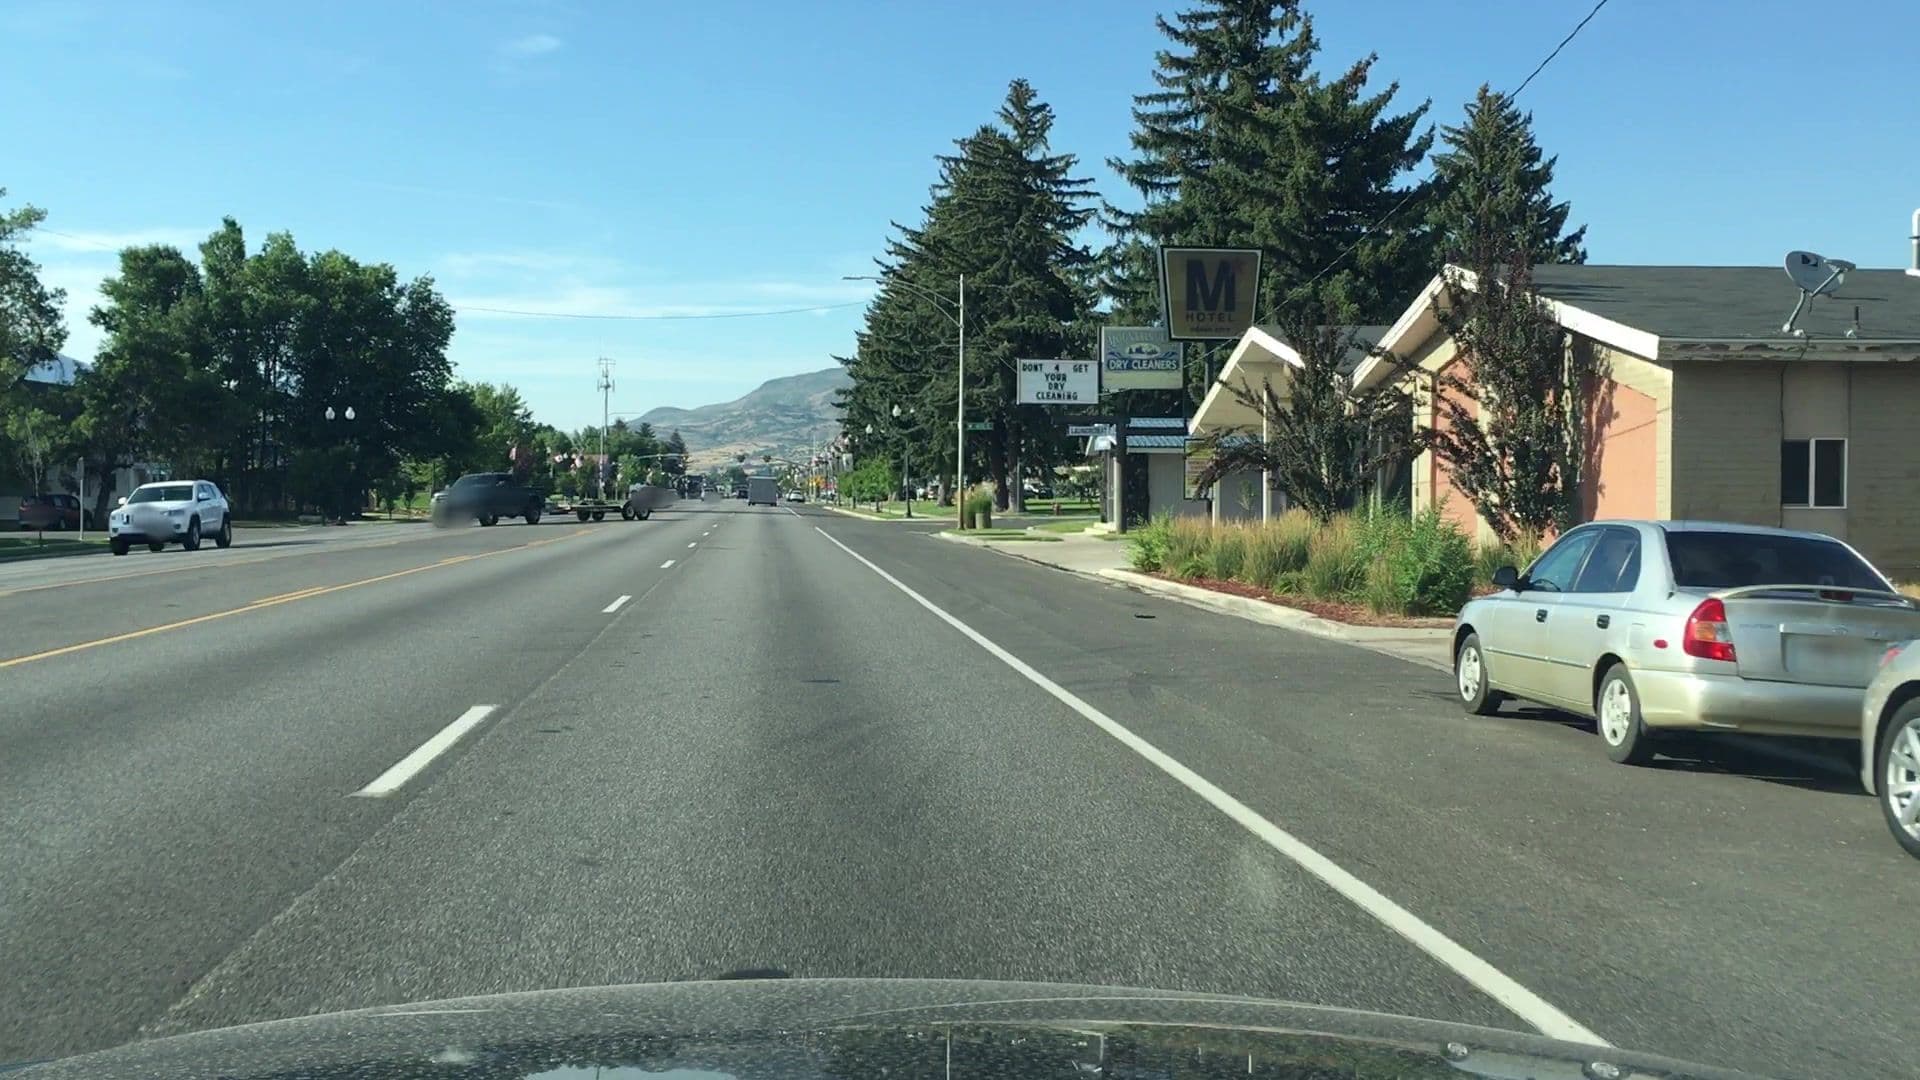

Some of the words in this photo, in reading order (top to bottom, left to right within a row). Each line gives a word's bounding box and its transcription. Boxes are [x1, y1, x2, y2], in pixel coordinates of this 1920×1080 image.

[1186, 259, 1236, 311] M
[1186, 312, 1234, 322] HOTEL
[1022, 363, 1043, 372] DONT
[1054, 364, 1060, 372] 4
[1073, 364, 1089, 373] GET
[1109, 360, 1128, 370] DRY
[1132, 360, 1177, 370] CLEANERS
[1045, 373, 1067, 382] YOUR
[1048, 382, 1065, 391] DRY
[1036, 392, 1078, 400] CLEANING
